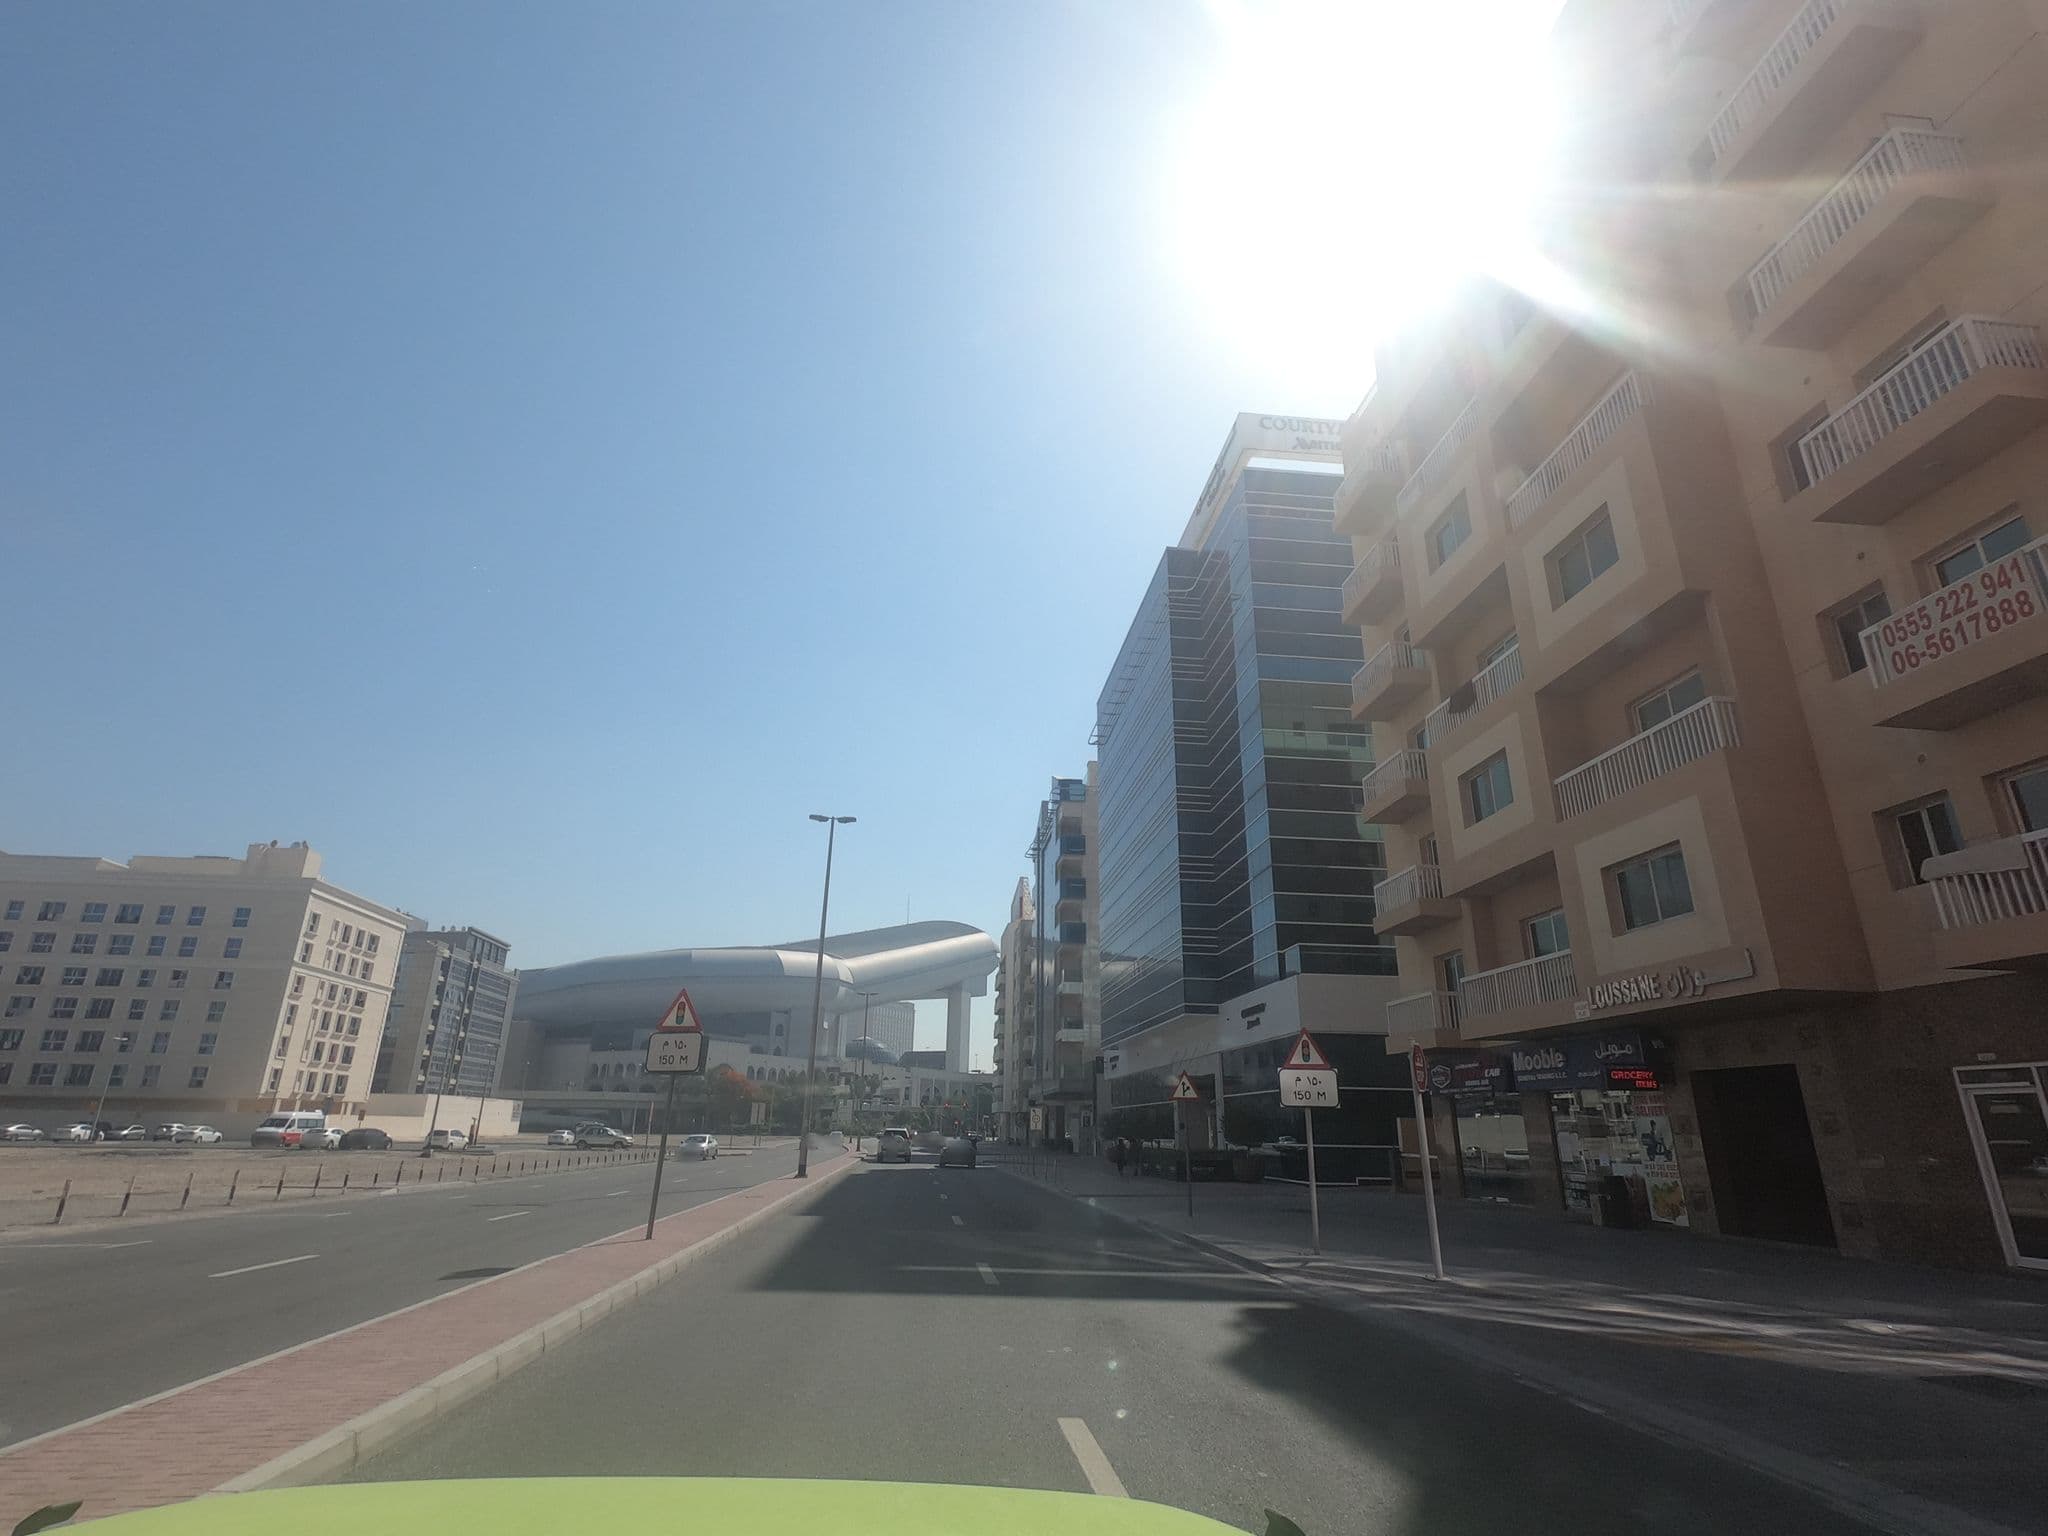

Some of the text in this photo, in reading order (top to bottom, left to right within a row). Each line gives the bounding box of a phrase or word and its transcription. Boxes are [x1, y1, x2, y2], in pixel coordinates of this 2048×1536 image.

[1882, 557, 2026, 647] 0555 222 941
[1891, 590, 2035, 674] 06-5617888
[1586, 974, 1661, 1010] LOUSSANE
[659, 1055, 688, 1065] 150 M
[1512, 1048, 1565, 1071] Mooble
[1610, 1070, 1654, 1080] GROCERY
[1294, 1091, 1326, 1101] 150 M
